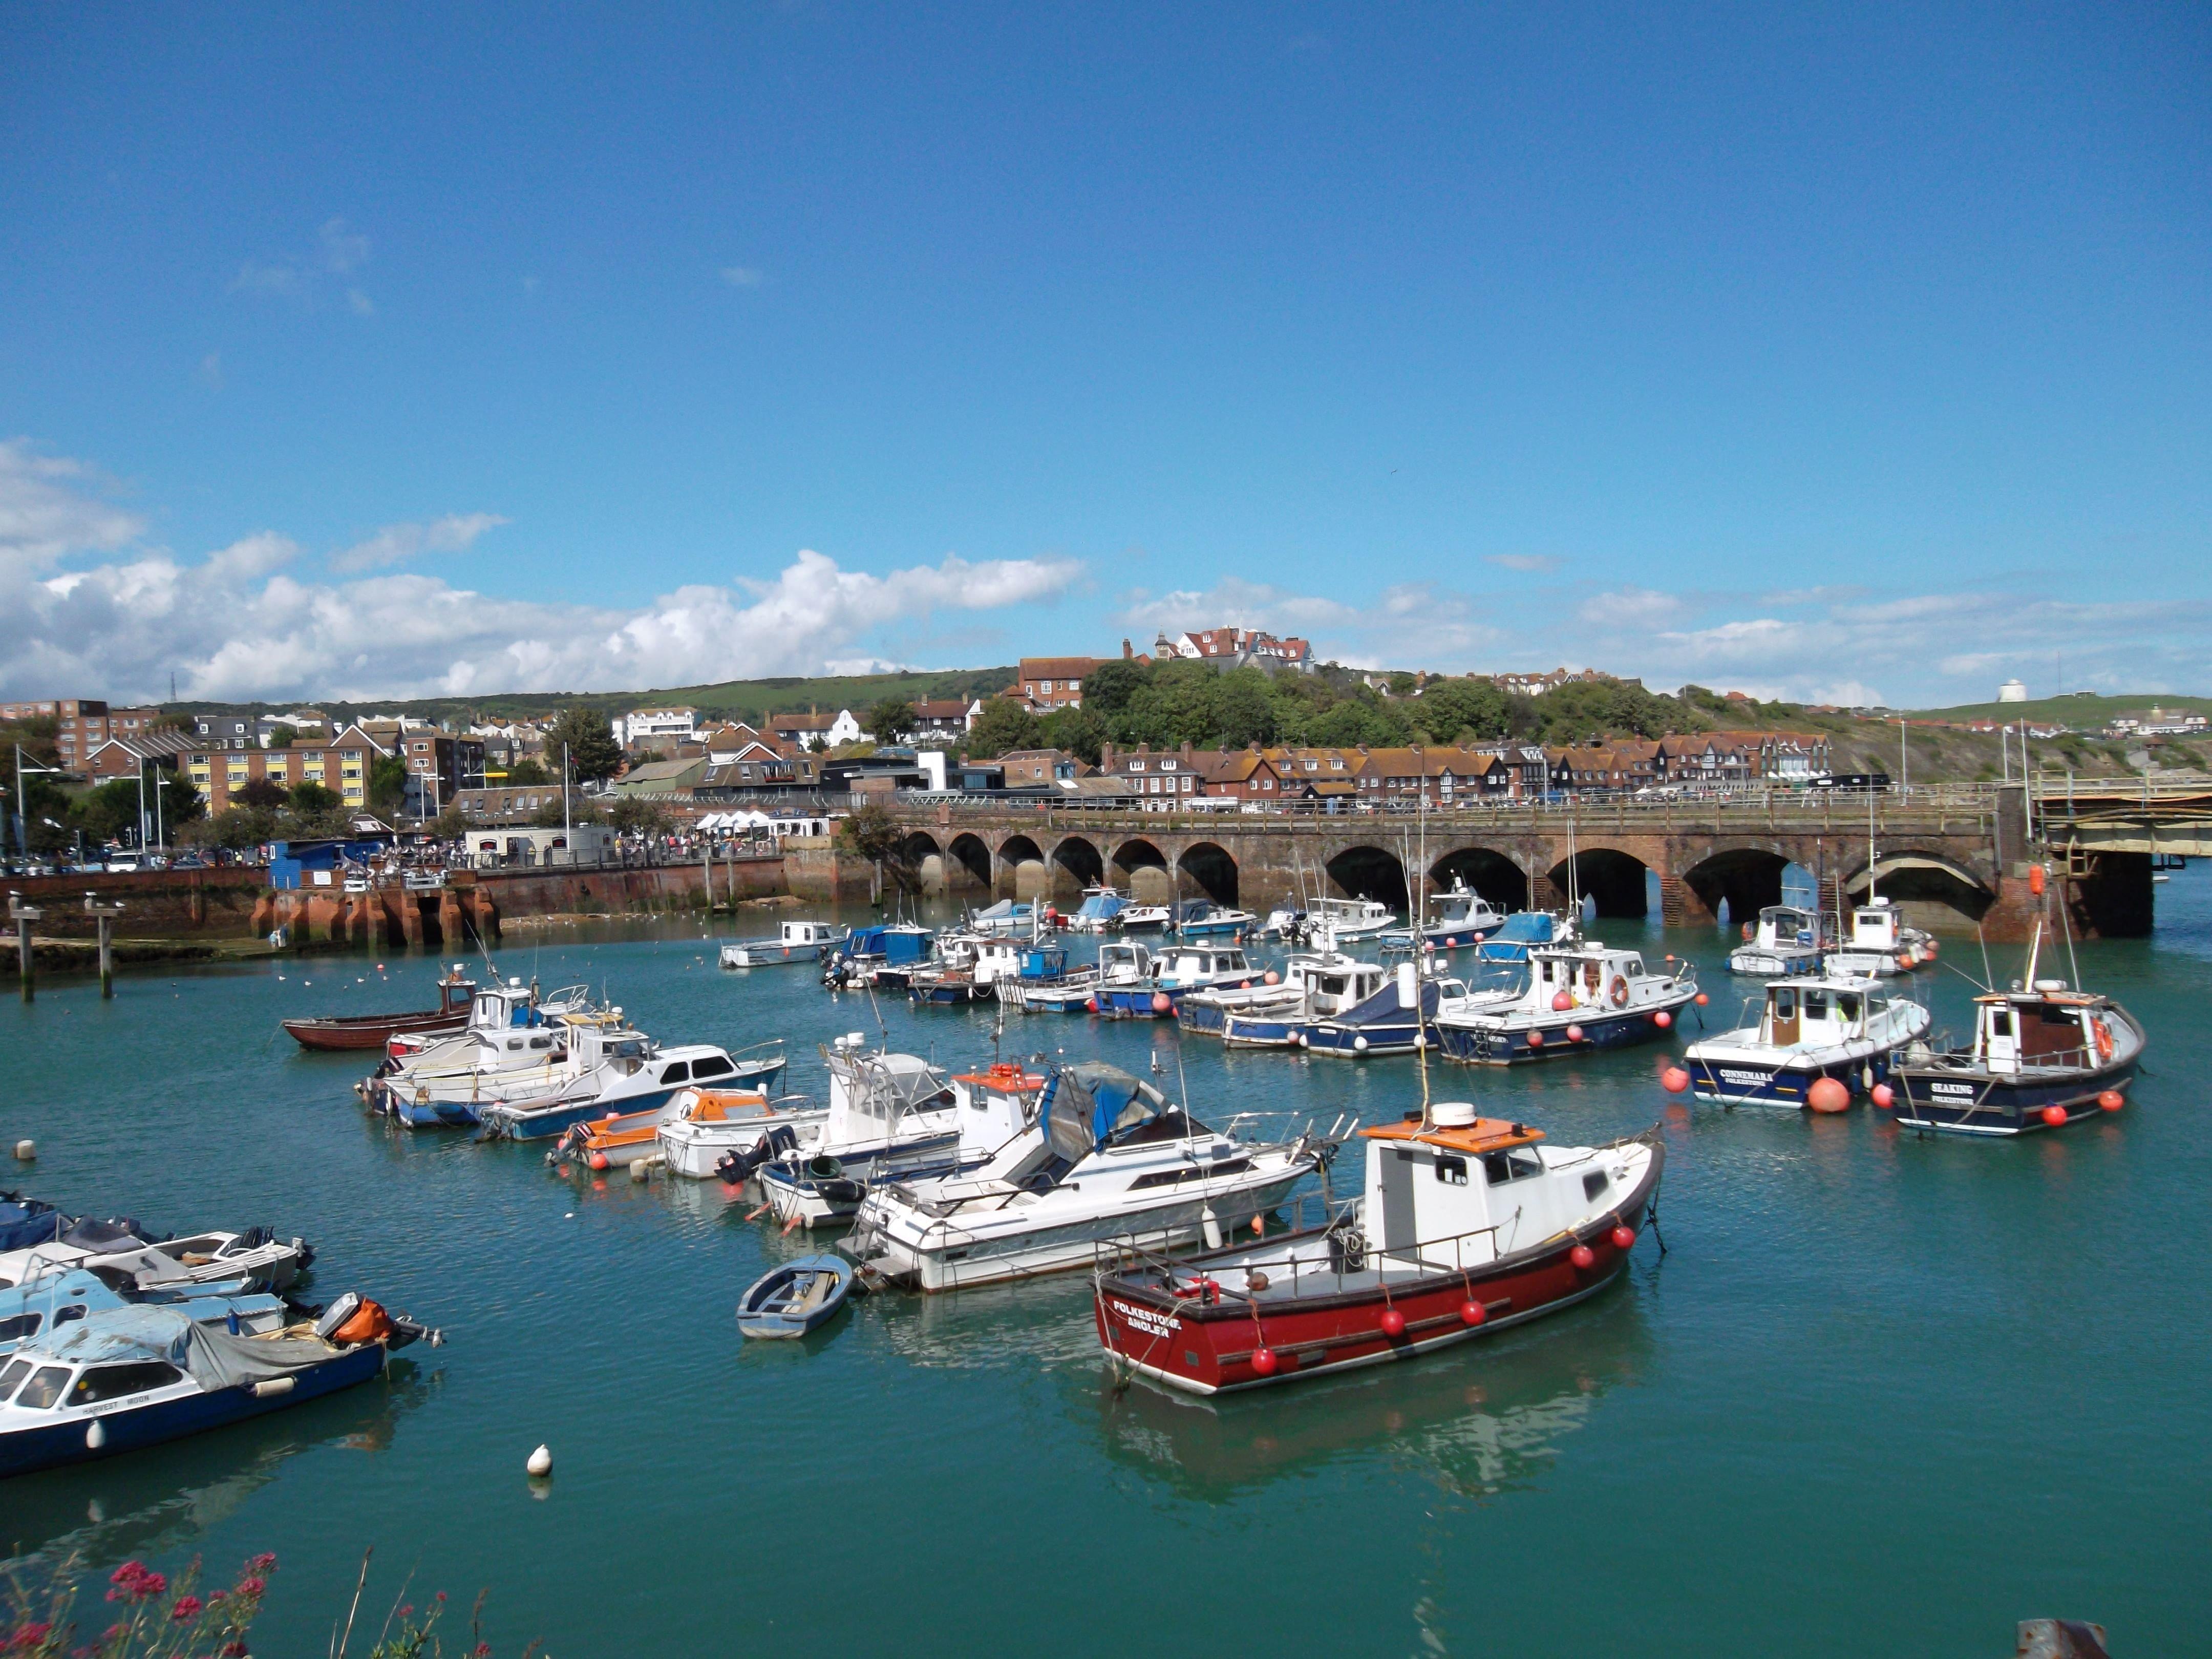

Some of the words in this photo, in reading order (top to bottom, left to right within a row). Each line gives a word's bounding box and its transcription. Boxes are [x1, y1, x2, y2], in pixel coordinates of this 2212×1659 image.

[1719, 1069, 1773, 1081] CONNEMARA
[1113, 1300, 1182, 1330] FOLKESTONE
[1128, 1316, 1169, 1338] ANGLER
[82, 1401, 118, 1415] HARVEST
[127, 1394, 150, 1405] MOON
